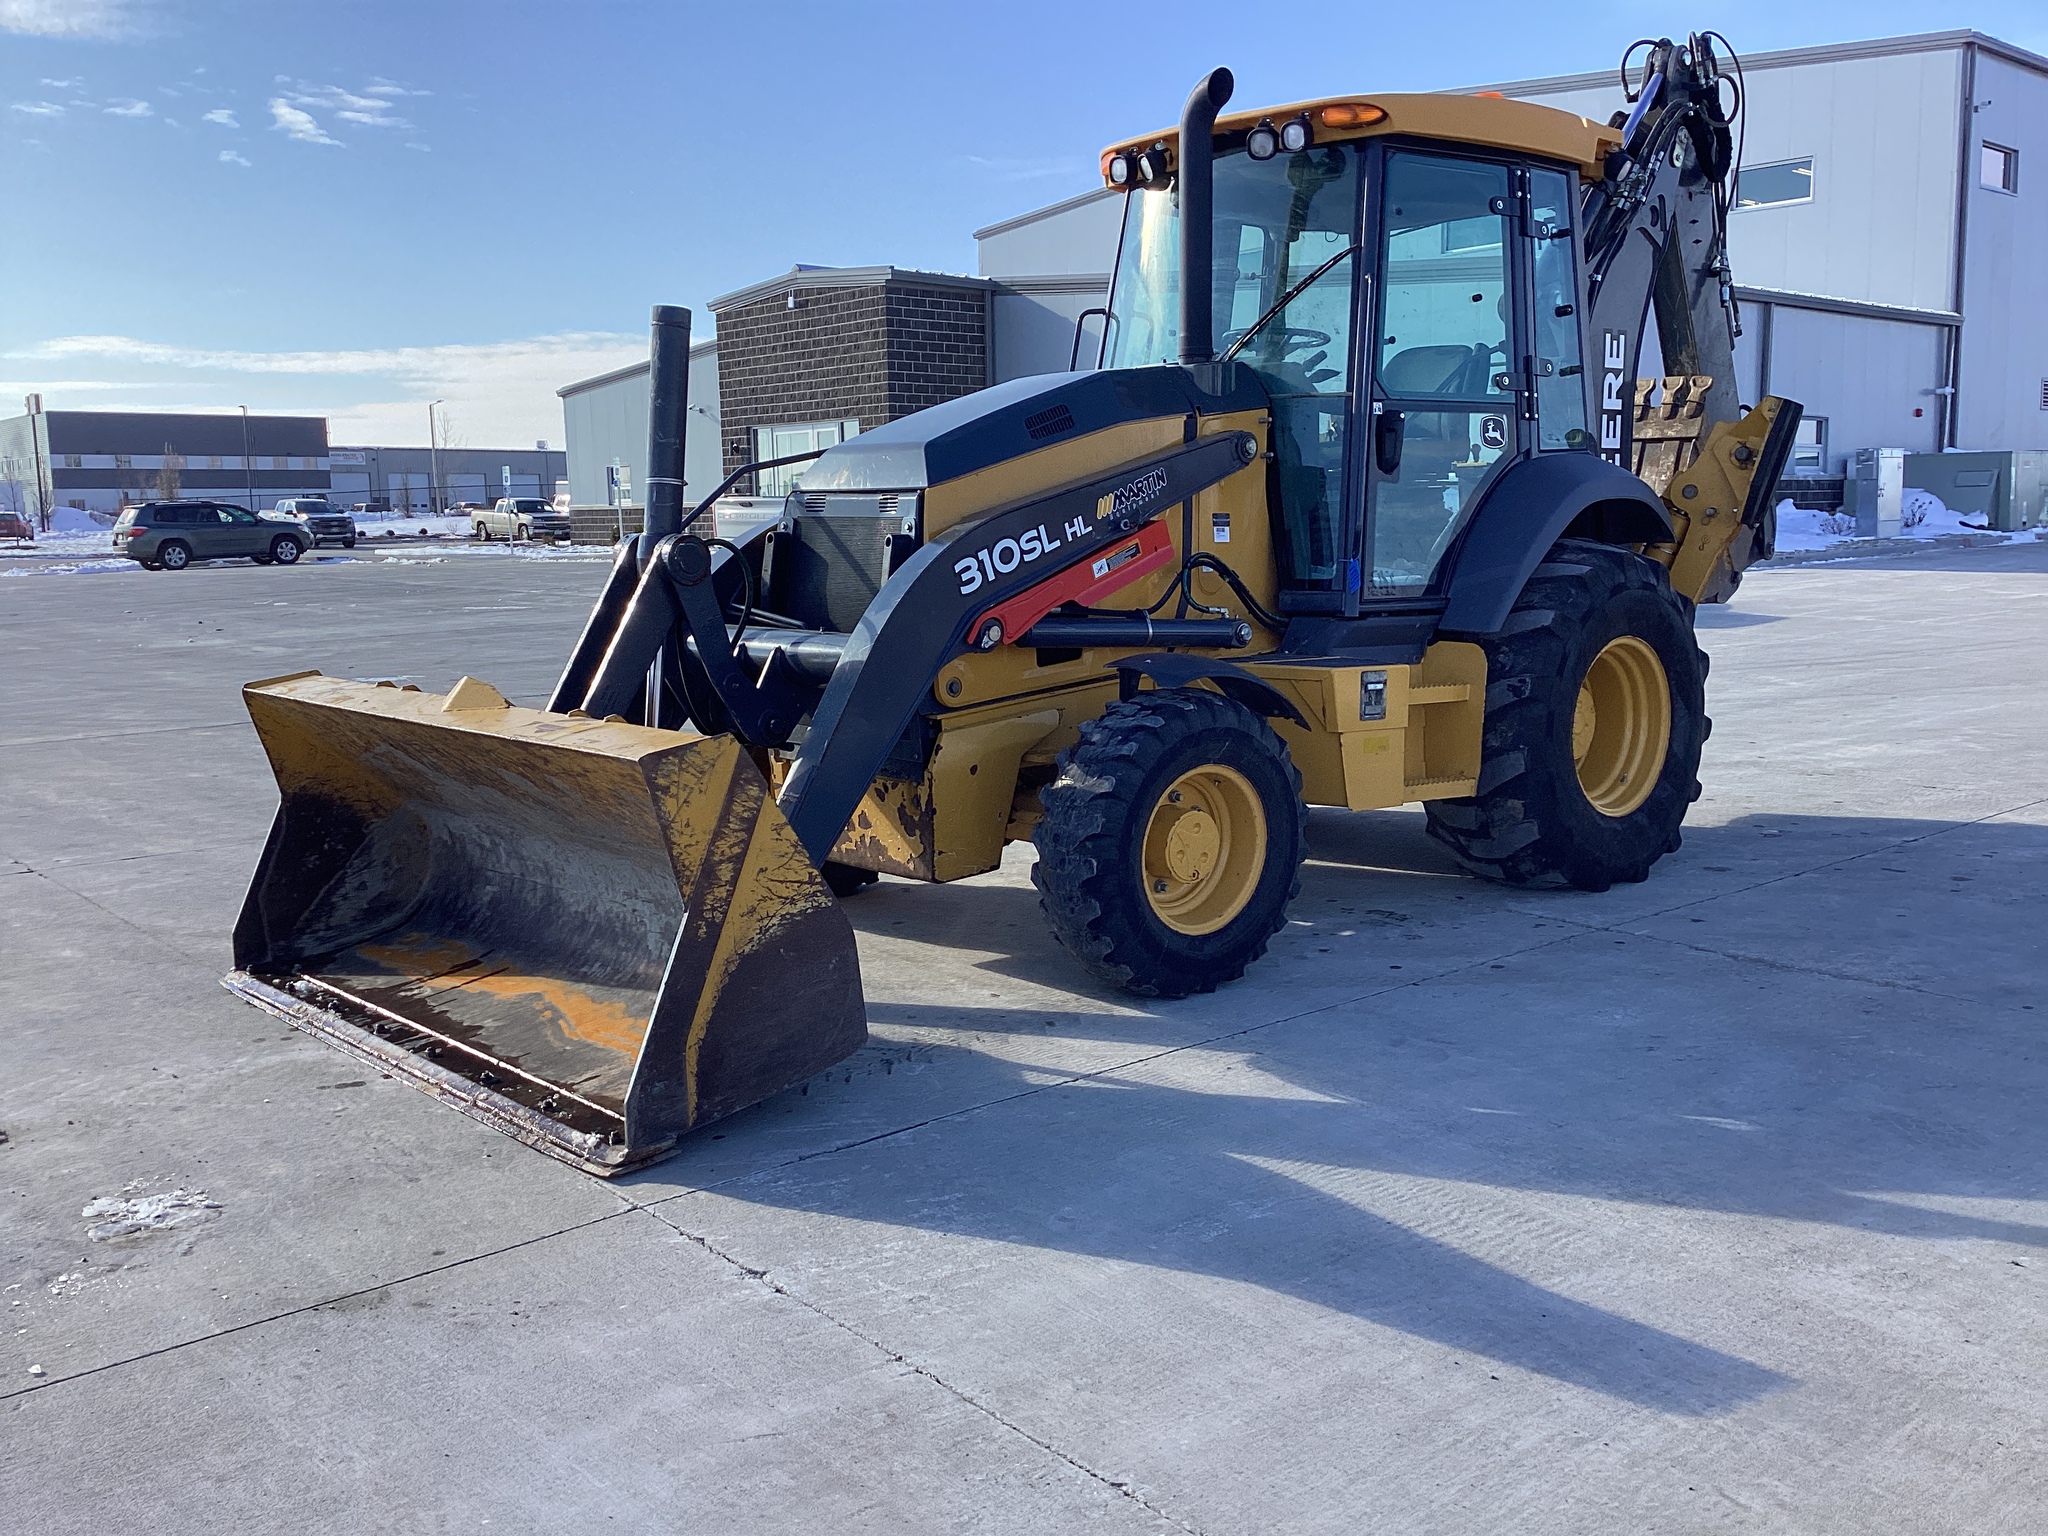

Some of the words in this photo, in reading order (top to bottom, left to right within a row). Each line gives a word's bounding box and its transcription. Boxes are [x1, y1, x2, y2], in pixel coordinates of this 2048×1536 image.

[1112, 467, 1167, 512] MARTIN
[954, 524, 1061, 595] 310SL
[1064, 515, 1093, 542] HL
